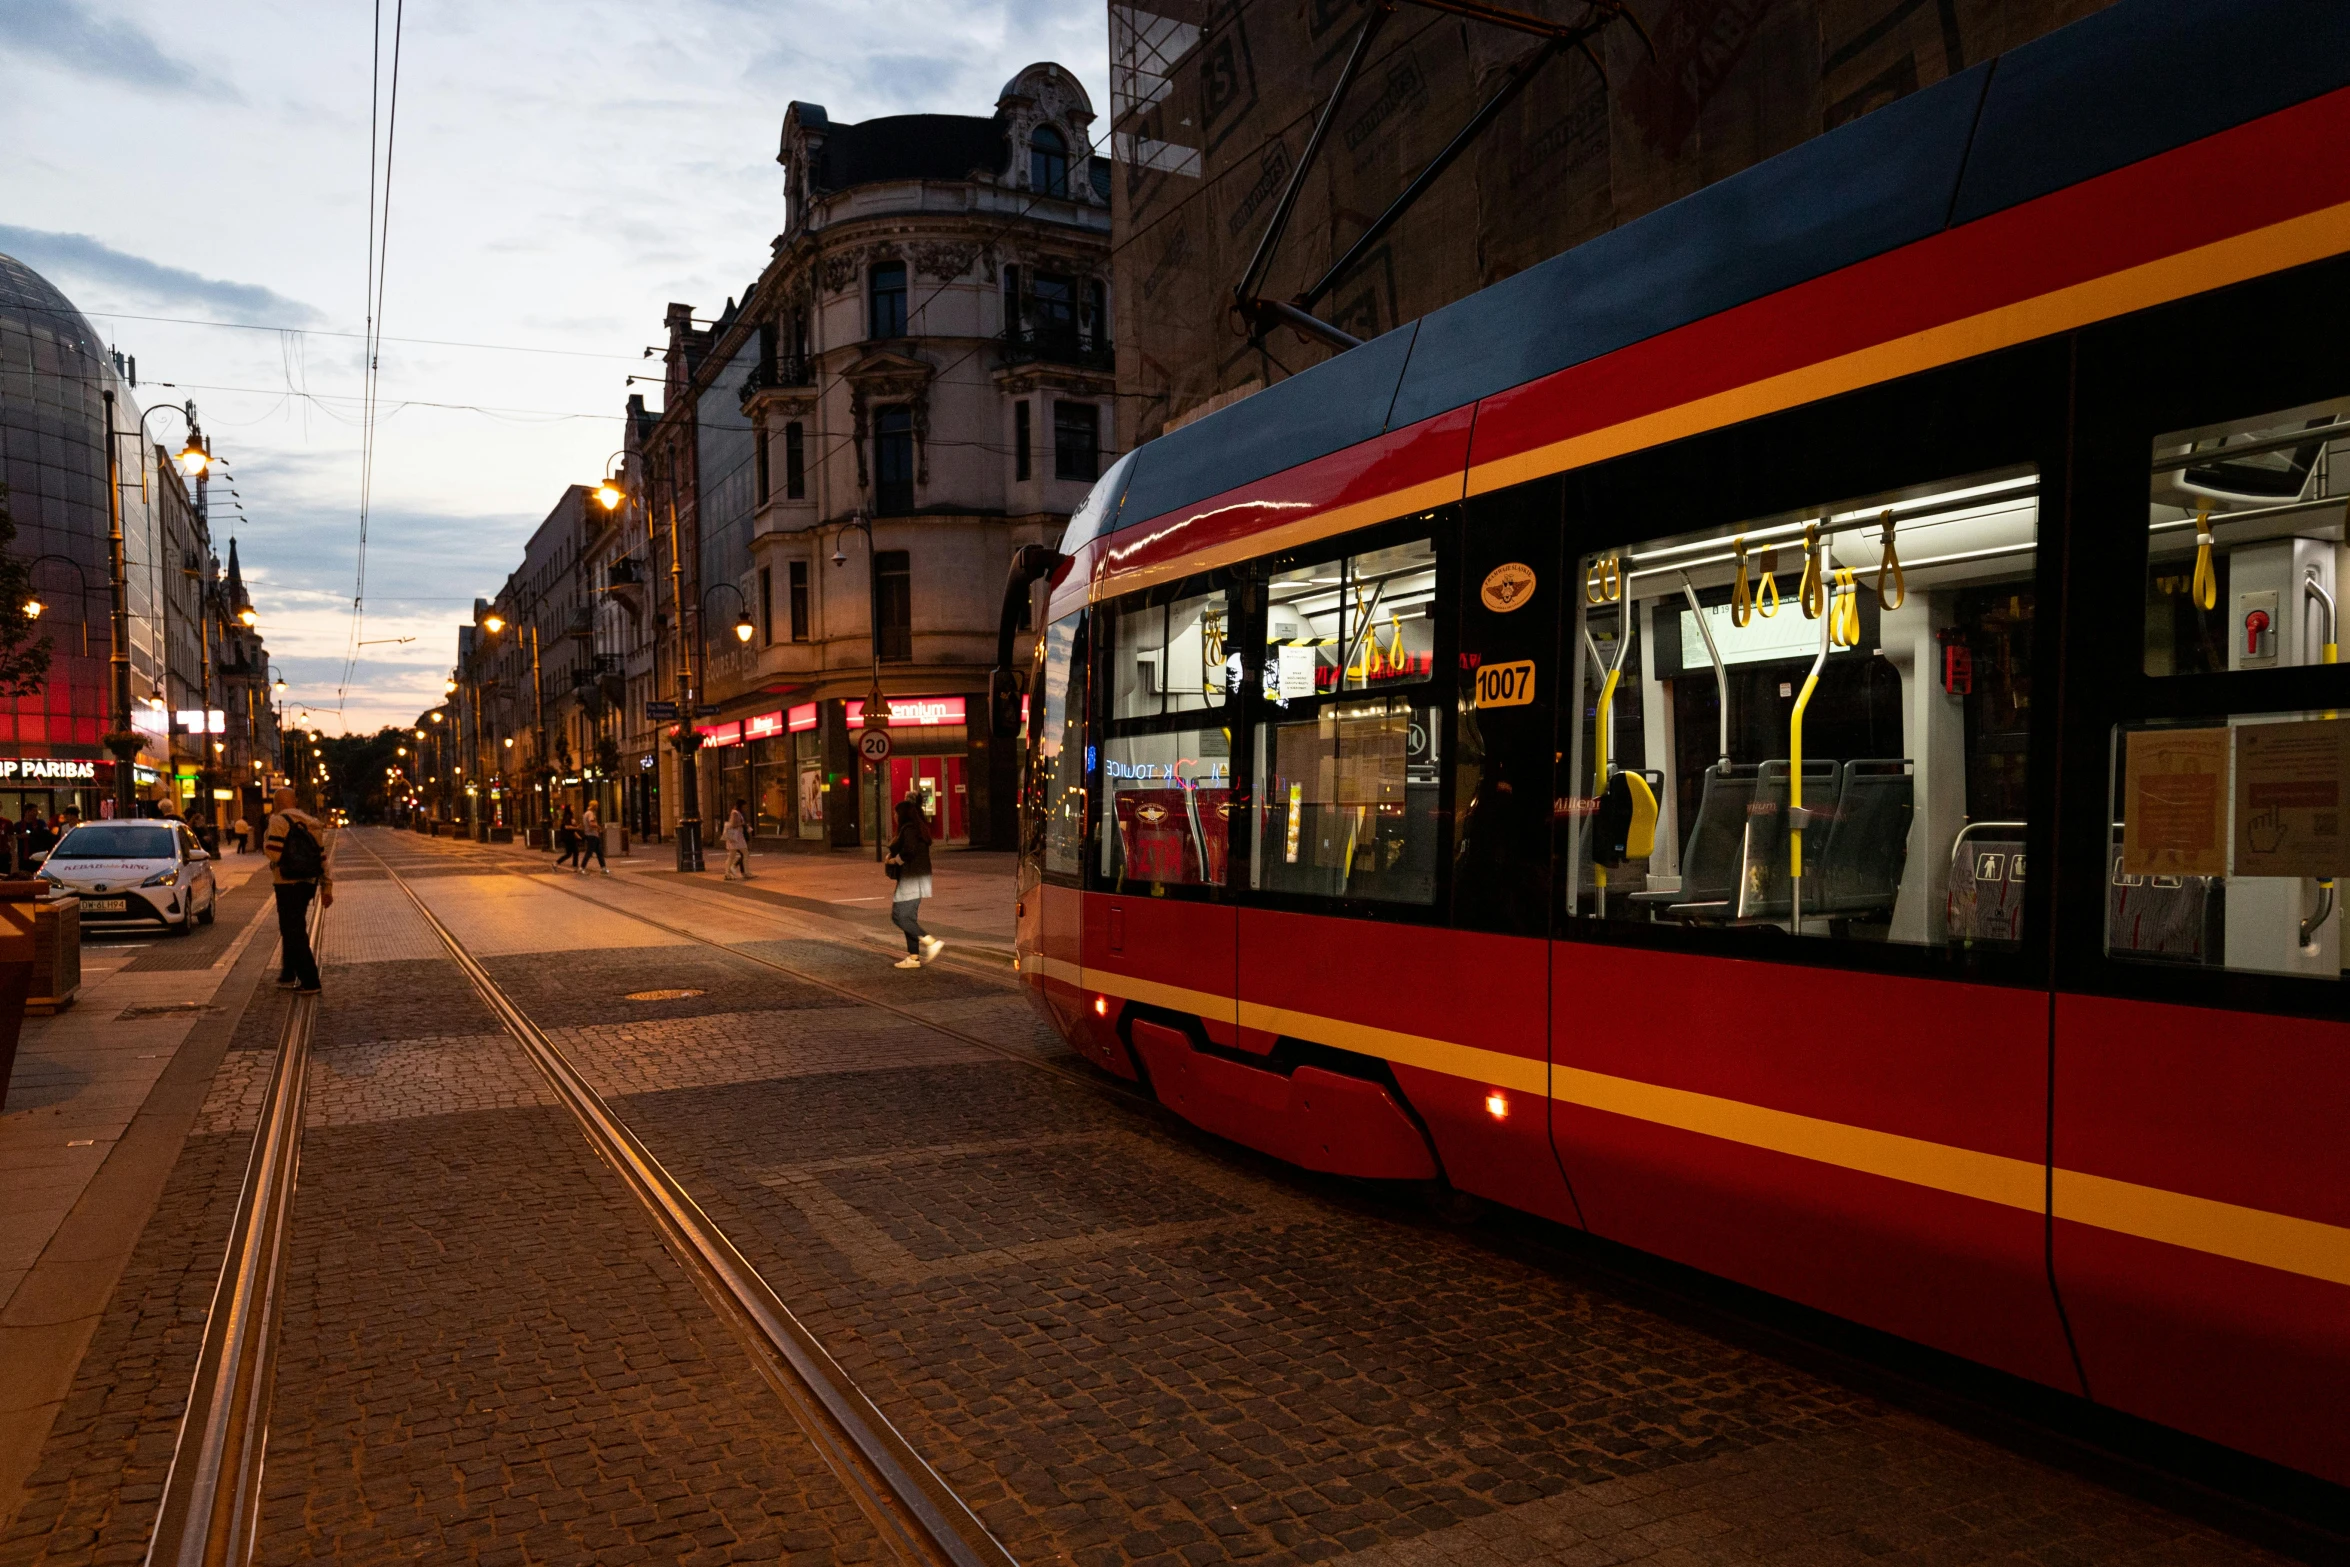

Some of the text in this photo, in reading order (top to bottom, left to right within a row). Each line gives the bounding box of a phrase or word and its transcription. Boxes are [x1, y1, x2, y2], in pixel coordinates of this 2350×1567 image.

[1485, 564, 1532, 586] TRAMWAJE ŚLĄSKIE
[1478, 666, 1532, 702] 1007
[865, 739, 886, 754] 20
[0, 760, 95, 778] P PARIBAS
[63, 863, 103, 871] KEBAB
[96, 900, 124, 909] 6LH94
